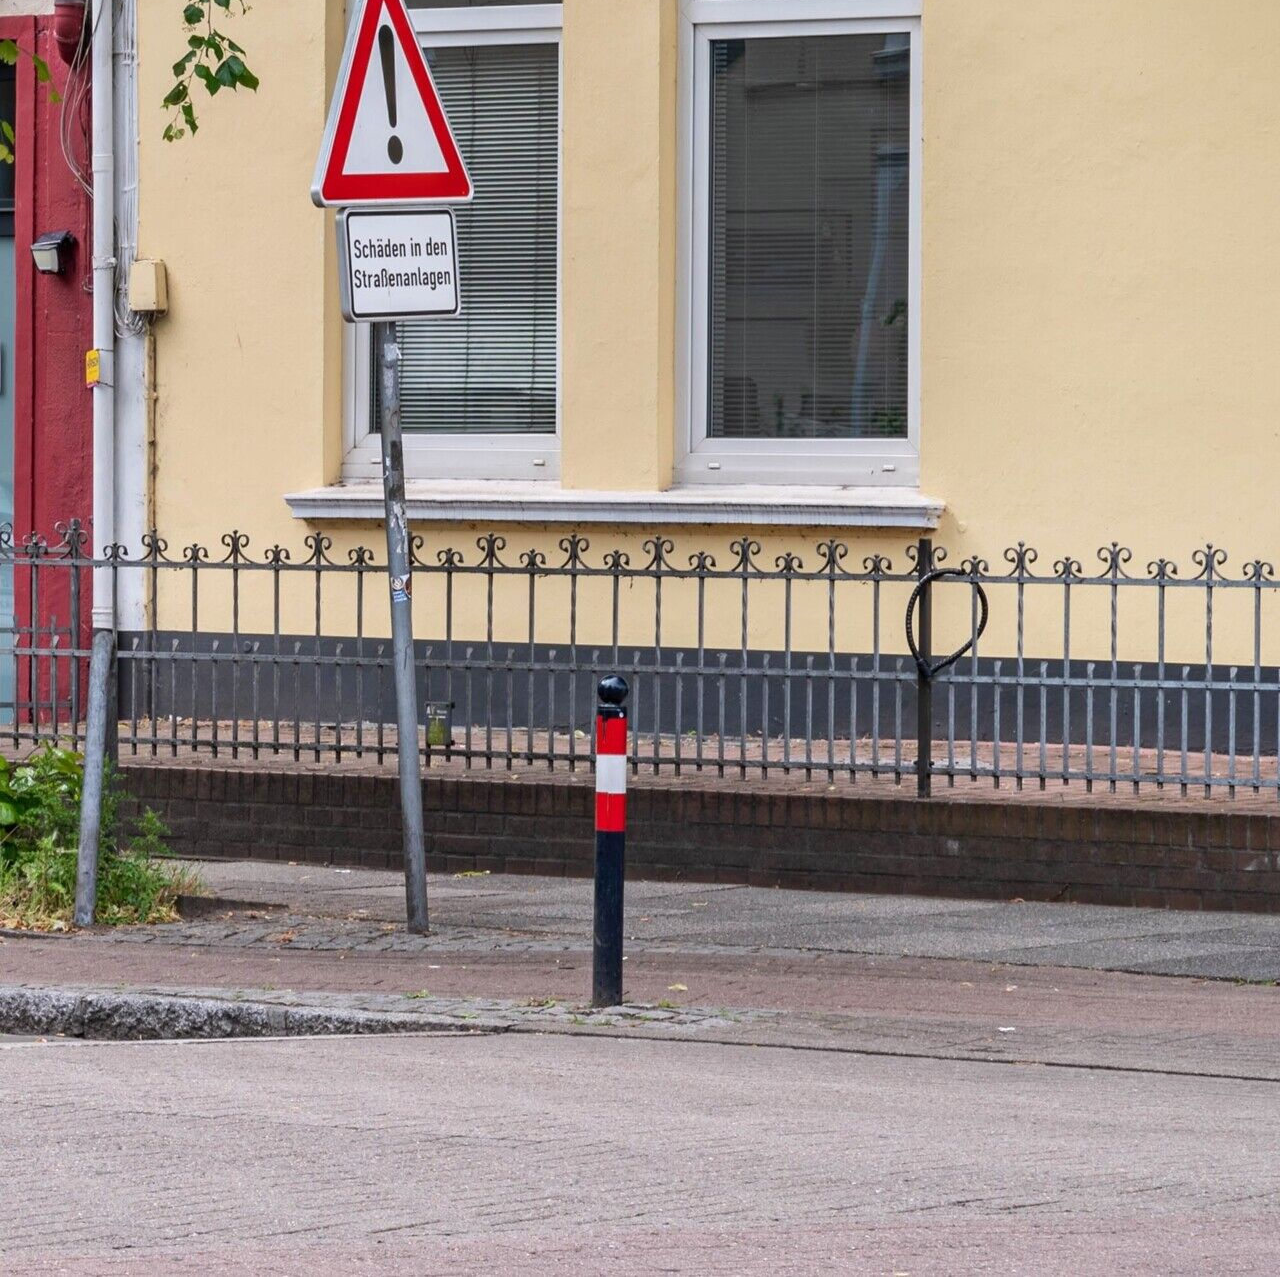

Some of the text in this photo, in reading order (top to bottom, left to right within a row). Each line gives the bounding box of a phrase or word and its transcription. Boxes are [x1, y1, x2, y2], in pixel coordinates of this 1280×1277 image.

[354, 237, 448, 258] Schäden in den
[354, 267, 451, 290] Straßenanlagen
